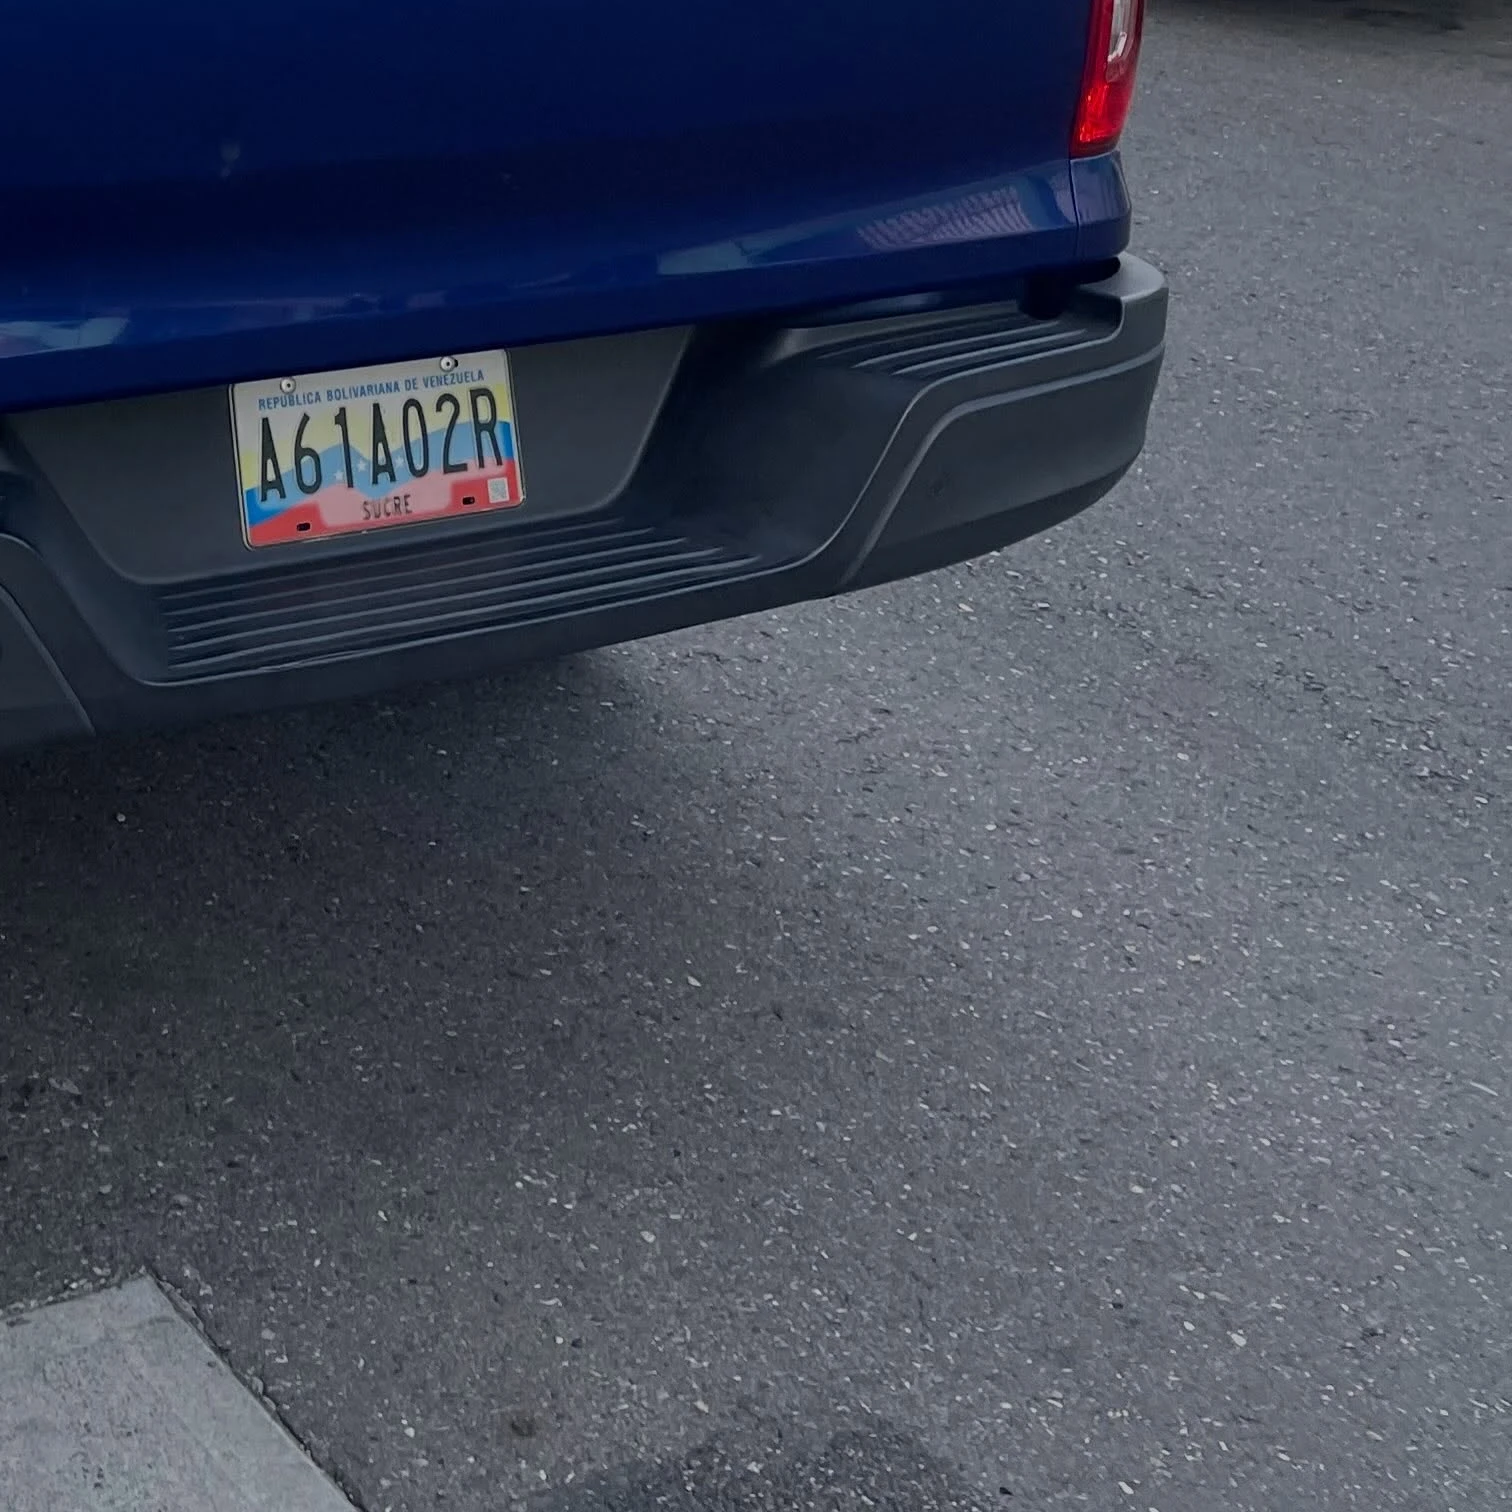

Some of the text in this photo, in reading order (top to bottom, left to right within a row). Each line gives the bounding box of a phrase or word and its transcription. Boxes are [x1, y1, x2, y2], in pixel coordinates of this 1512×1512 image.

[326, 381, 401, 402] BOLIVARIANA
[404, 378, 419, 391] DE
[422, 369, 485, 389] VENEZUELA
[260, 388, 504, 503] A61A02R
[362, 494, 413, 520] SUCRE
